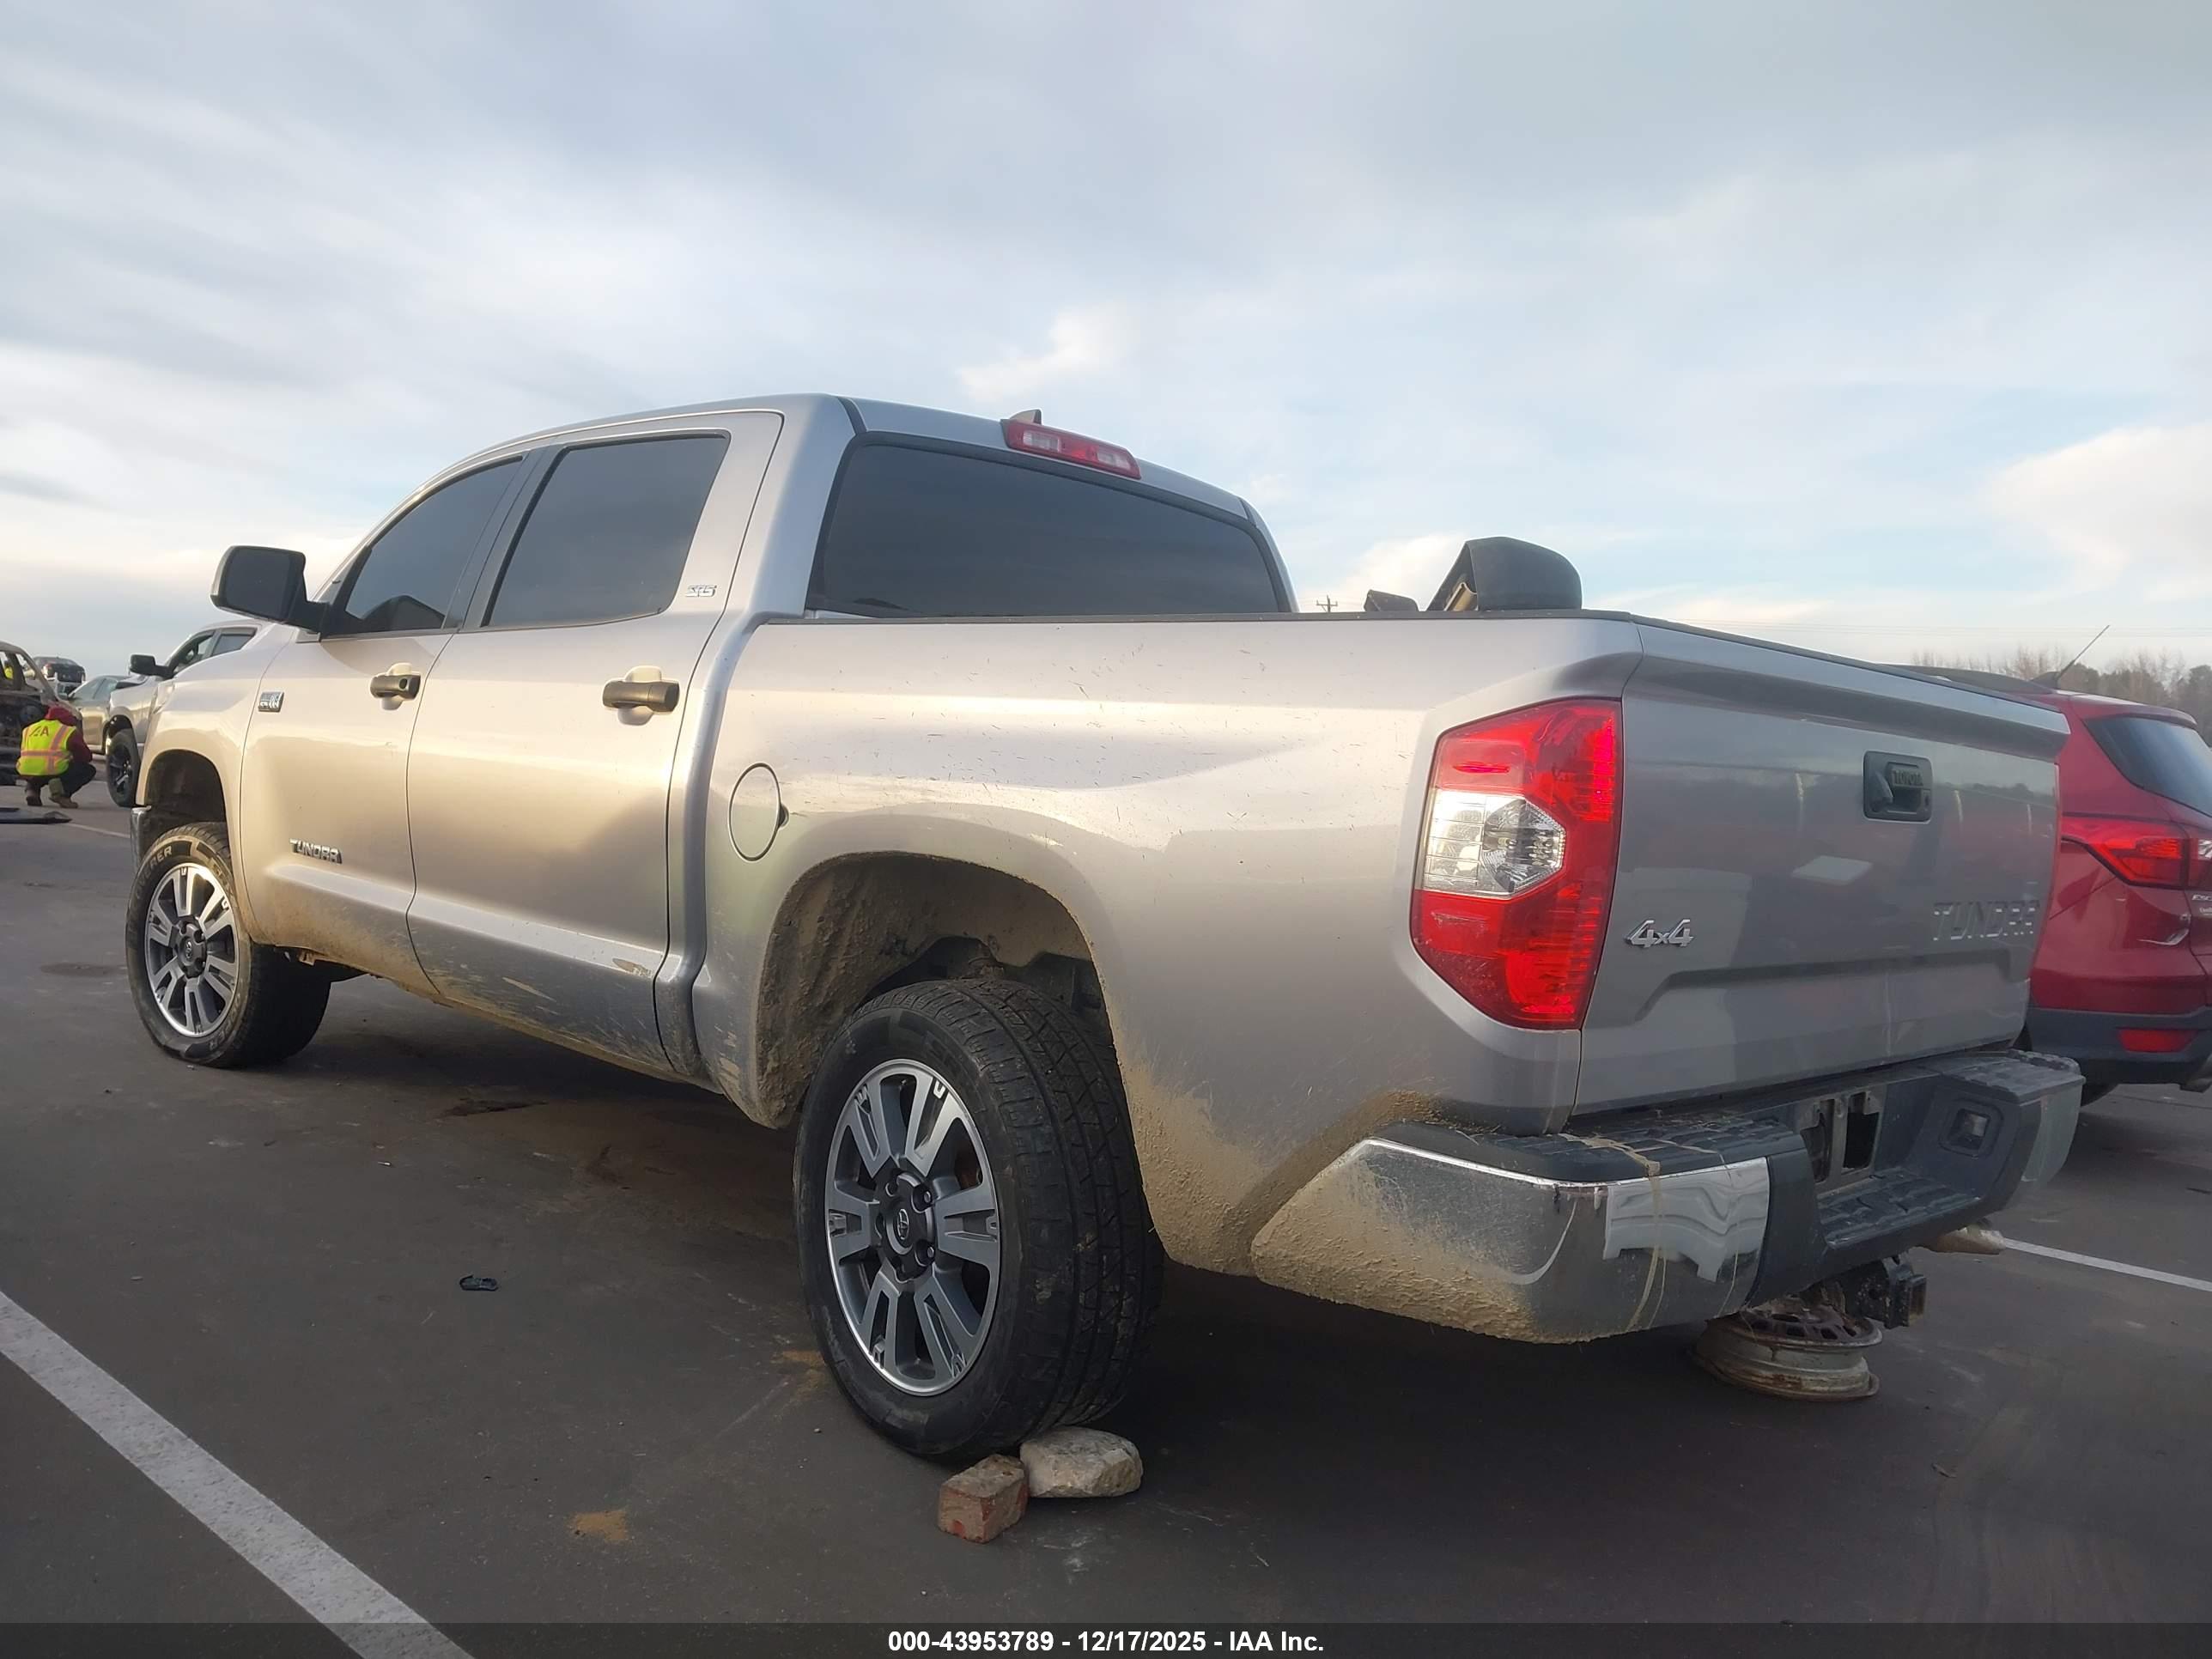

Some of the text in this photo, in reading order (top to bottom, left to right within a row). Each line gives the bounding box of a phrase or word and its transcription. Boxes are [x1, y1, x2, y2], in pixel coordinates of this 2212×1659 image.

[289, 838, 343, 865] TUNDRA
[1626, 919, 1695, 948] 4x4
[1932, 901, 2040, 941] TUNDRA
